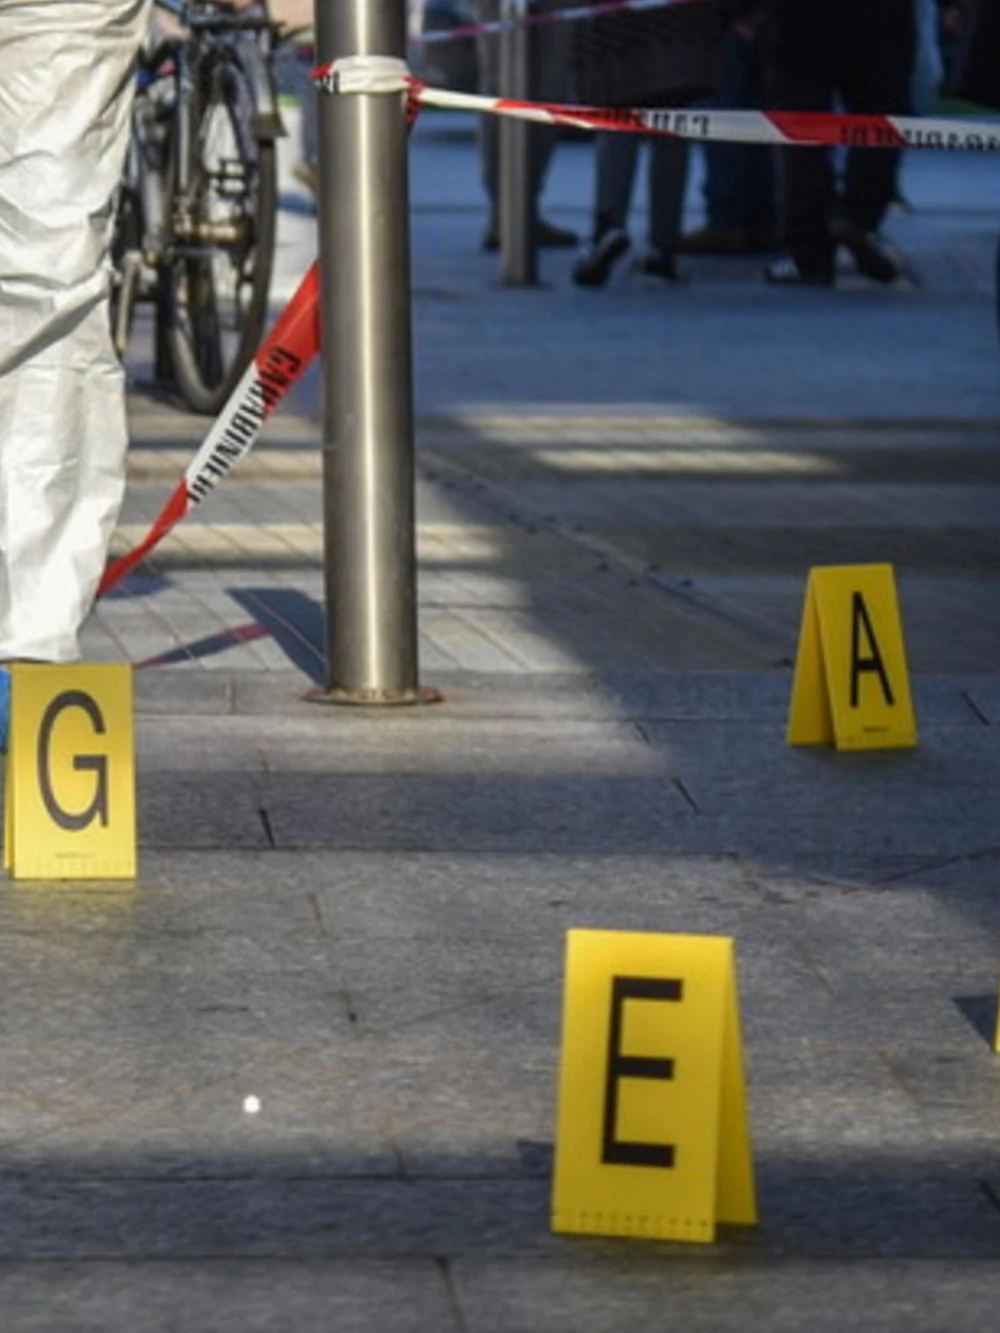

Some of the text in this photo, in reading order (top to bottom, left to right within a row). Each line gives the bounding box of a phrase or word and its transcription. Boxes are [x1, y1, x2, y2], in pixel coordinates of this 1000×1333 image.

[850, 590, 895, 709] A
[36, 688, 109, 833] G
[600, 974, 683, 1169] E
